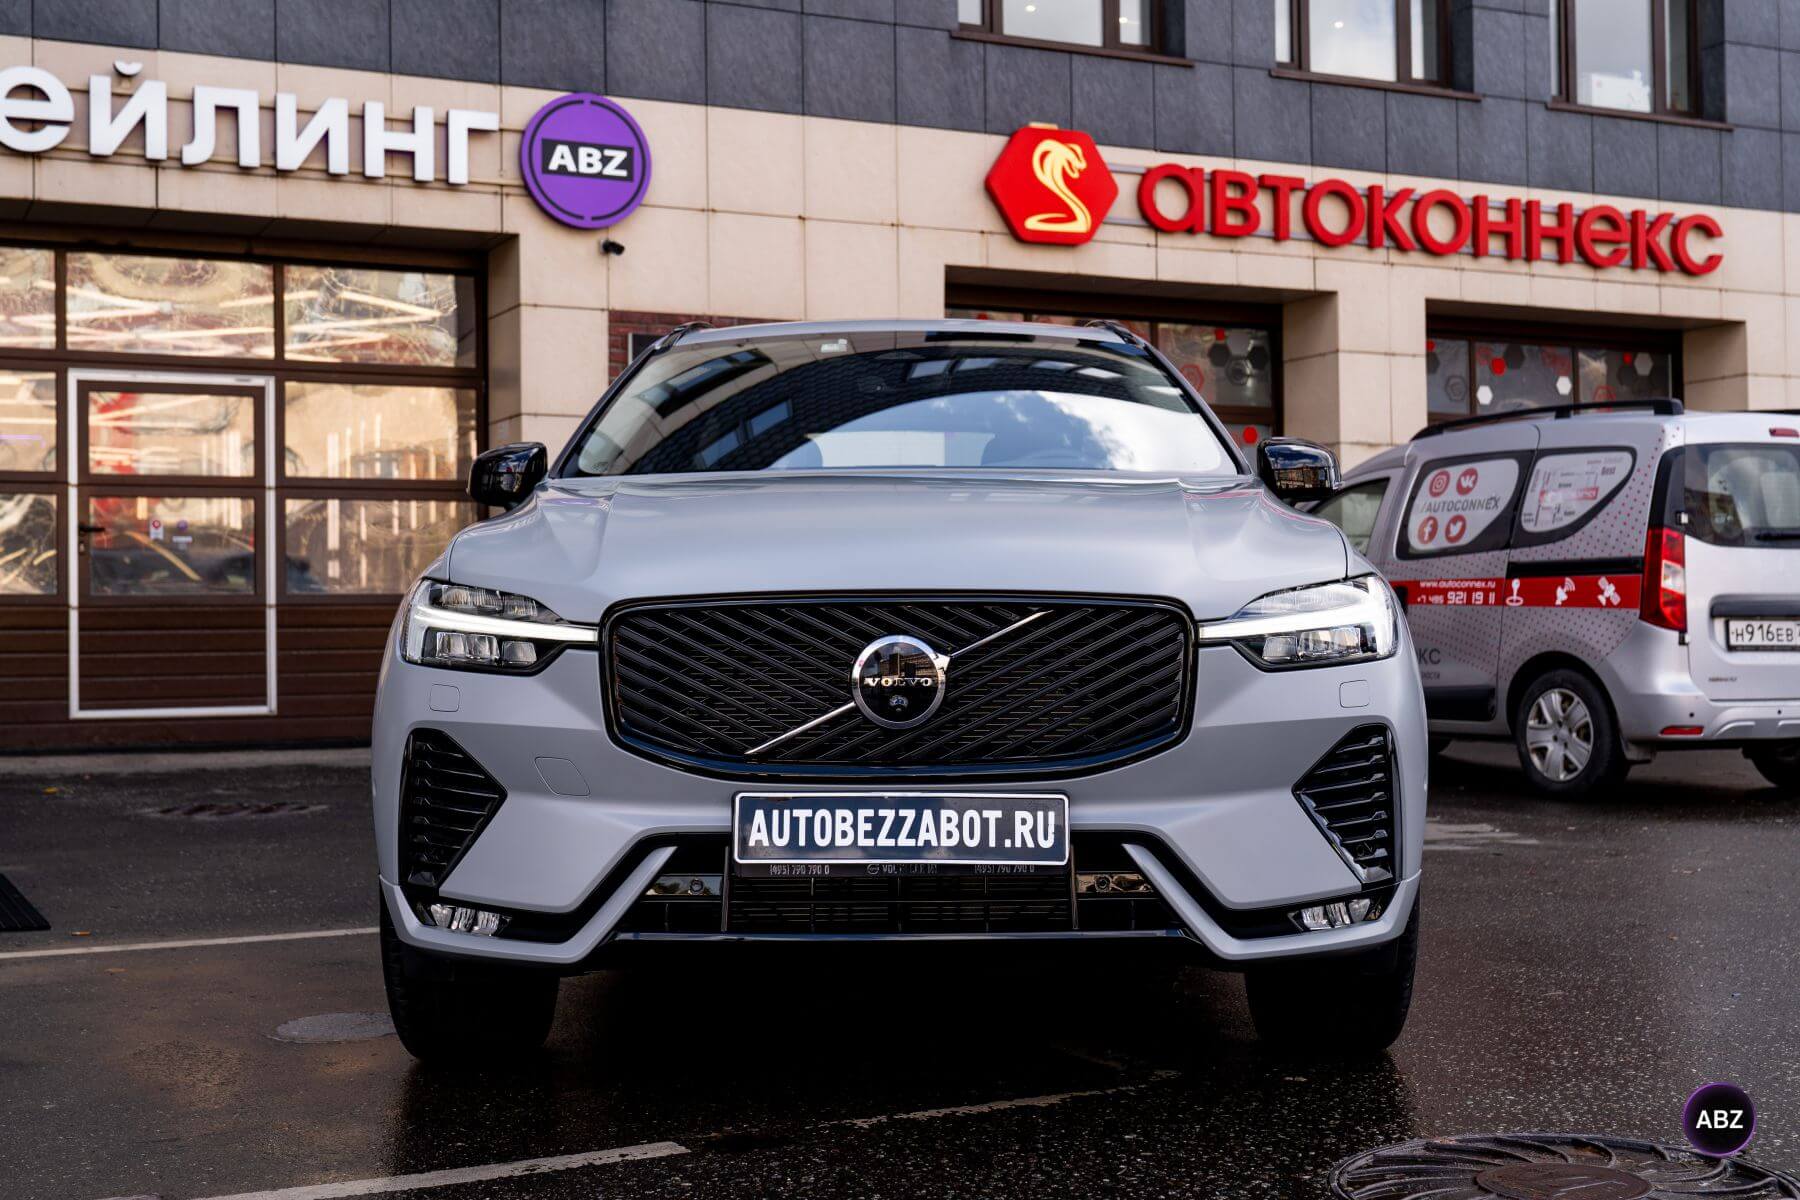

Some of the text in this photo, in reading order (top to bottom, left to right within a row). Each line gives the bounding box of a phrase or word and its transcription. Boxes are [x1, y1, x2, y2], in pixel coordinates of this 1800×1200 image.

[548, 143, 629, 178] ABZ
[1447, 591, 1467, 605] 921
[1472, 591, 1484, 605] 19
[1489, 592, 1496, 605] 11
[864, 677, 932, 687] VOLVO
[749, 809, 1056, 848] AUTOBEZZABOT.RU
